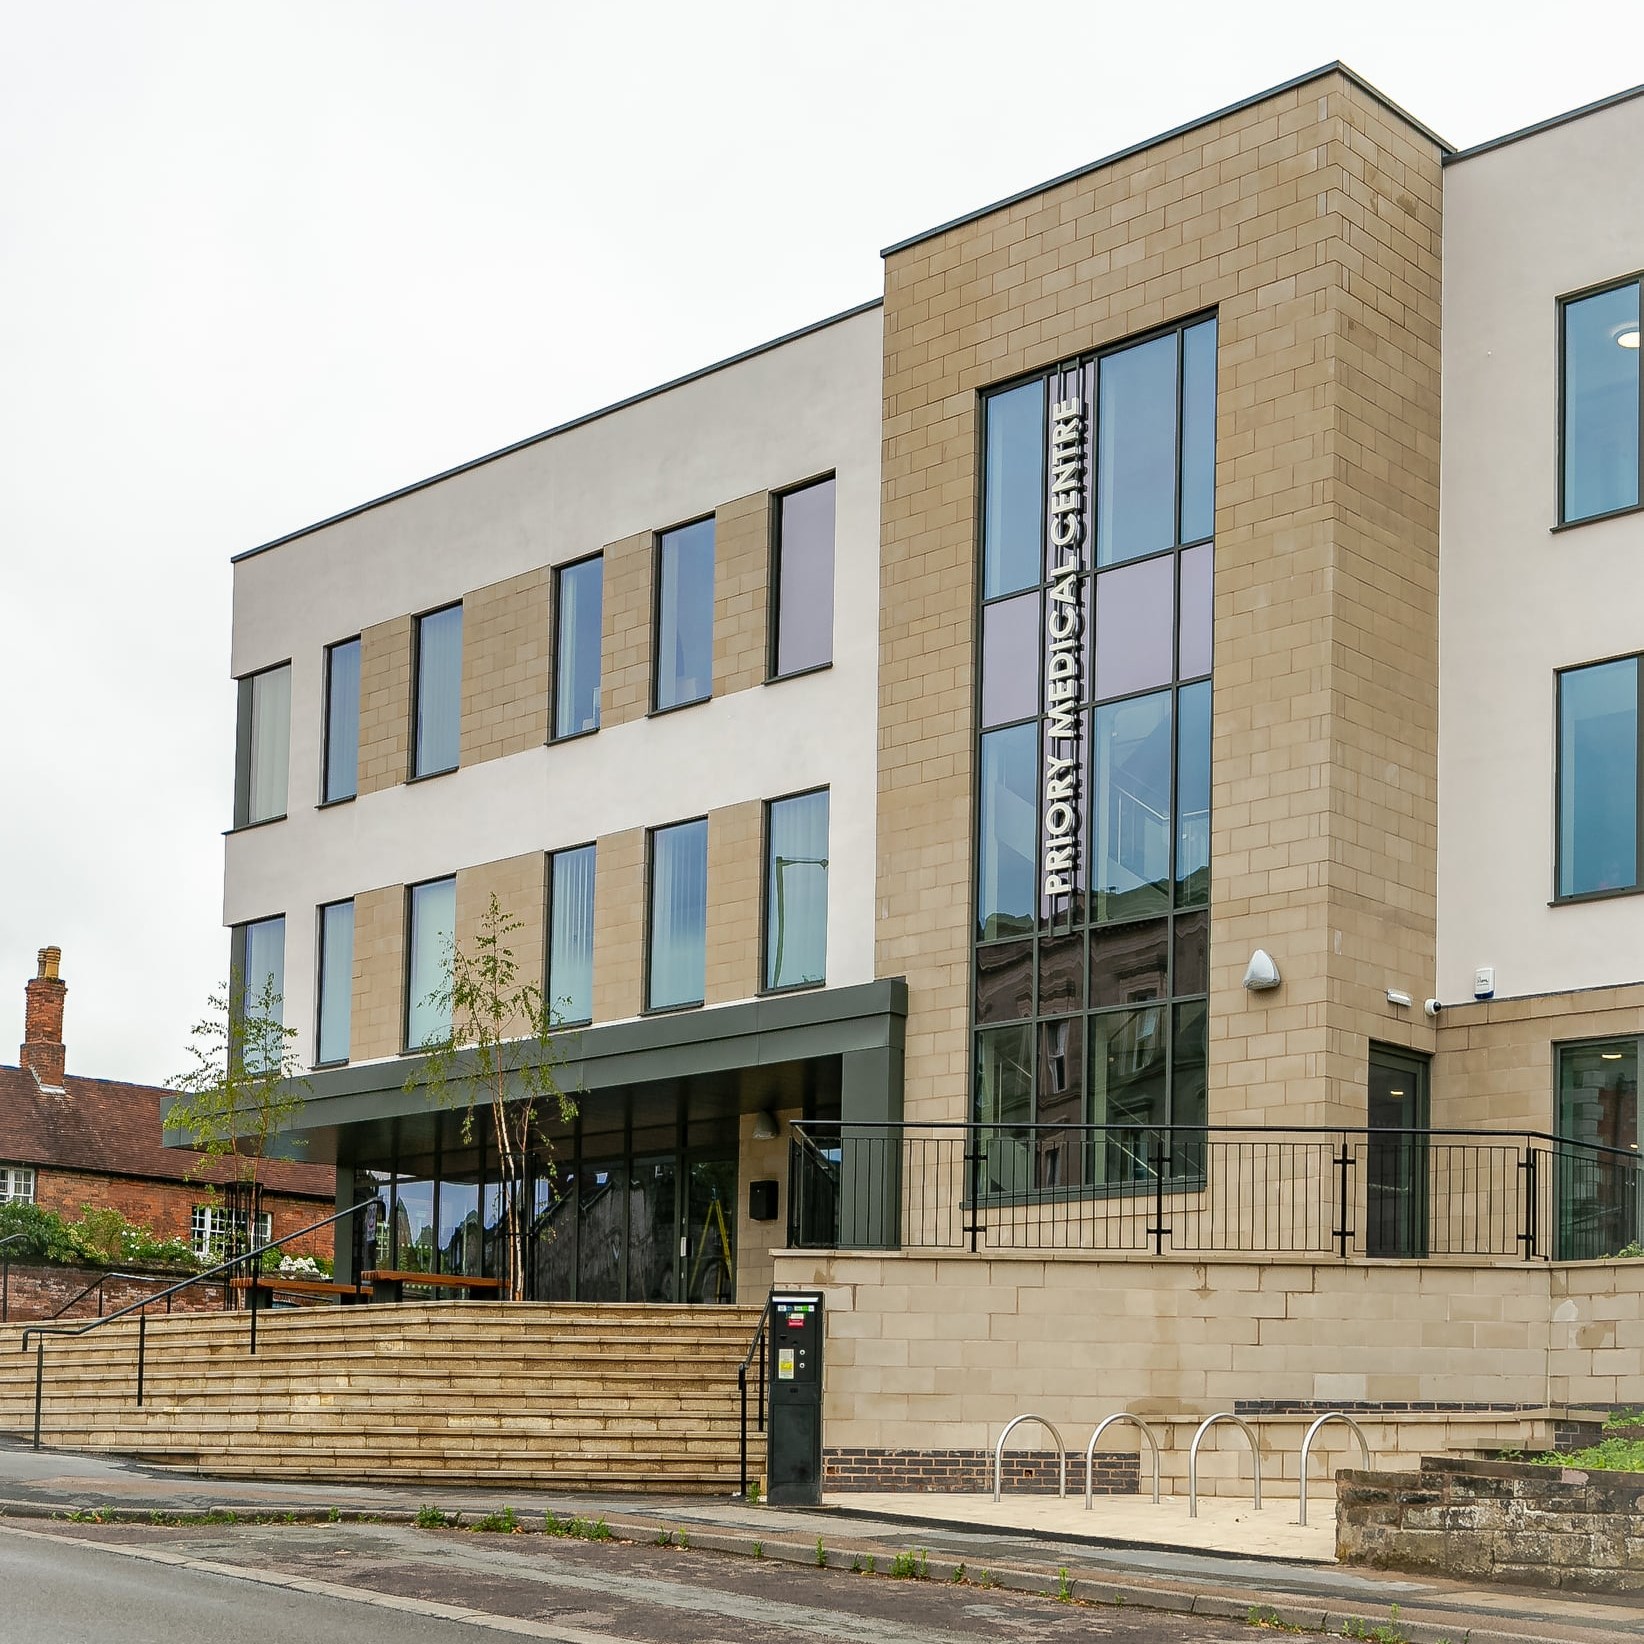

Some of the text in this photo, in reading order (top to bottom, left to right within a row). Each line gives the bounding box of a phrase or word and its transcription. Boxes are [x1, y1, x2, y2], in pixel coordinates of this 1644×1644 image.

[1045, 397, 1080, 895] PRIORY MEDICAL CENTRE
